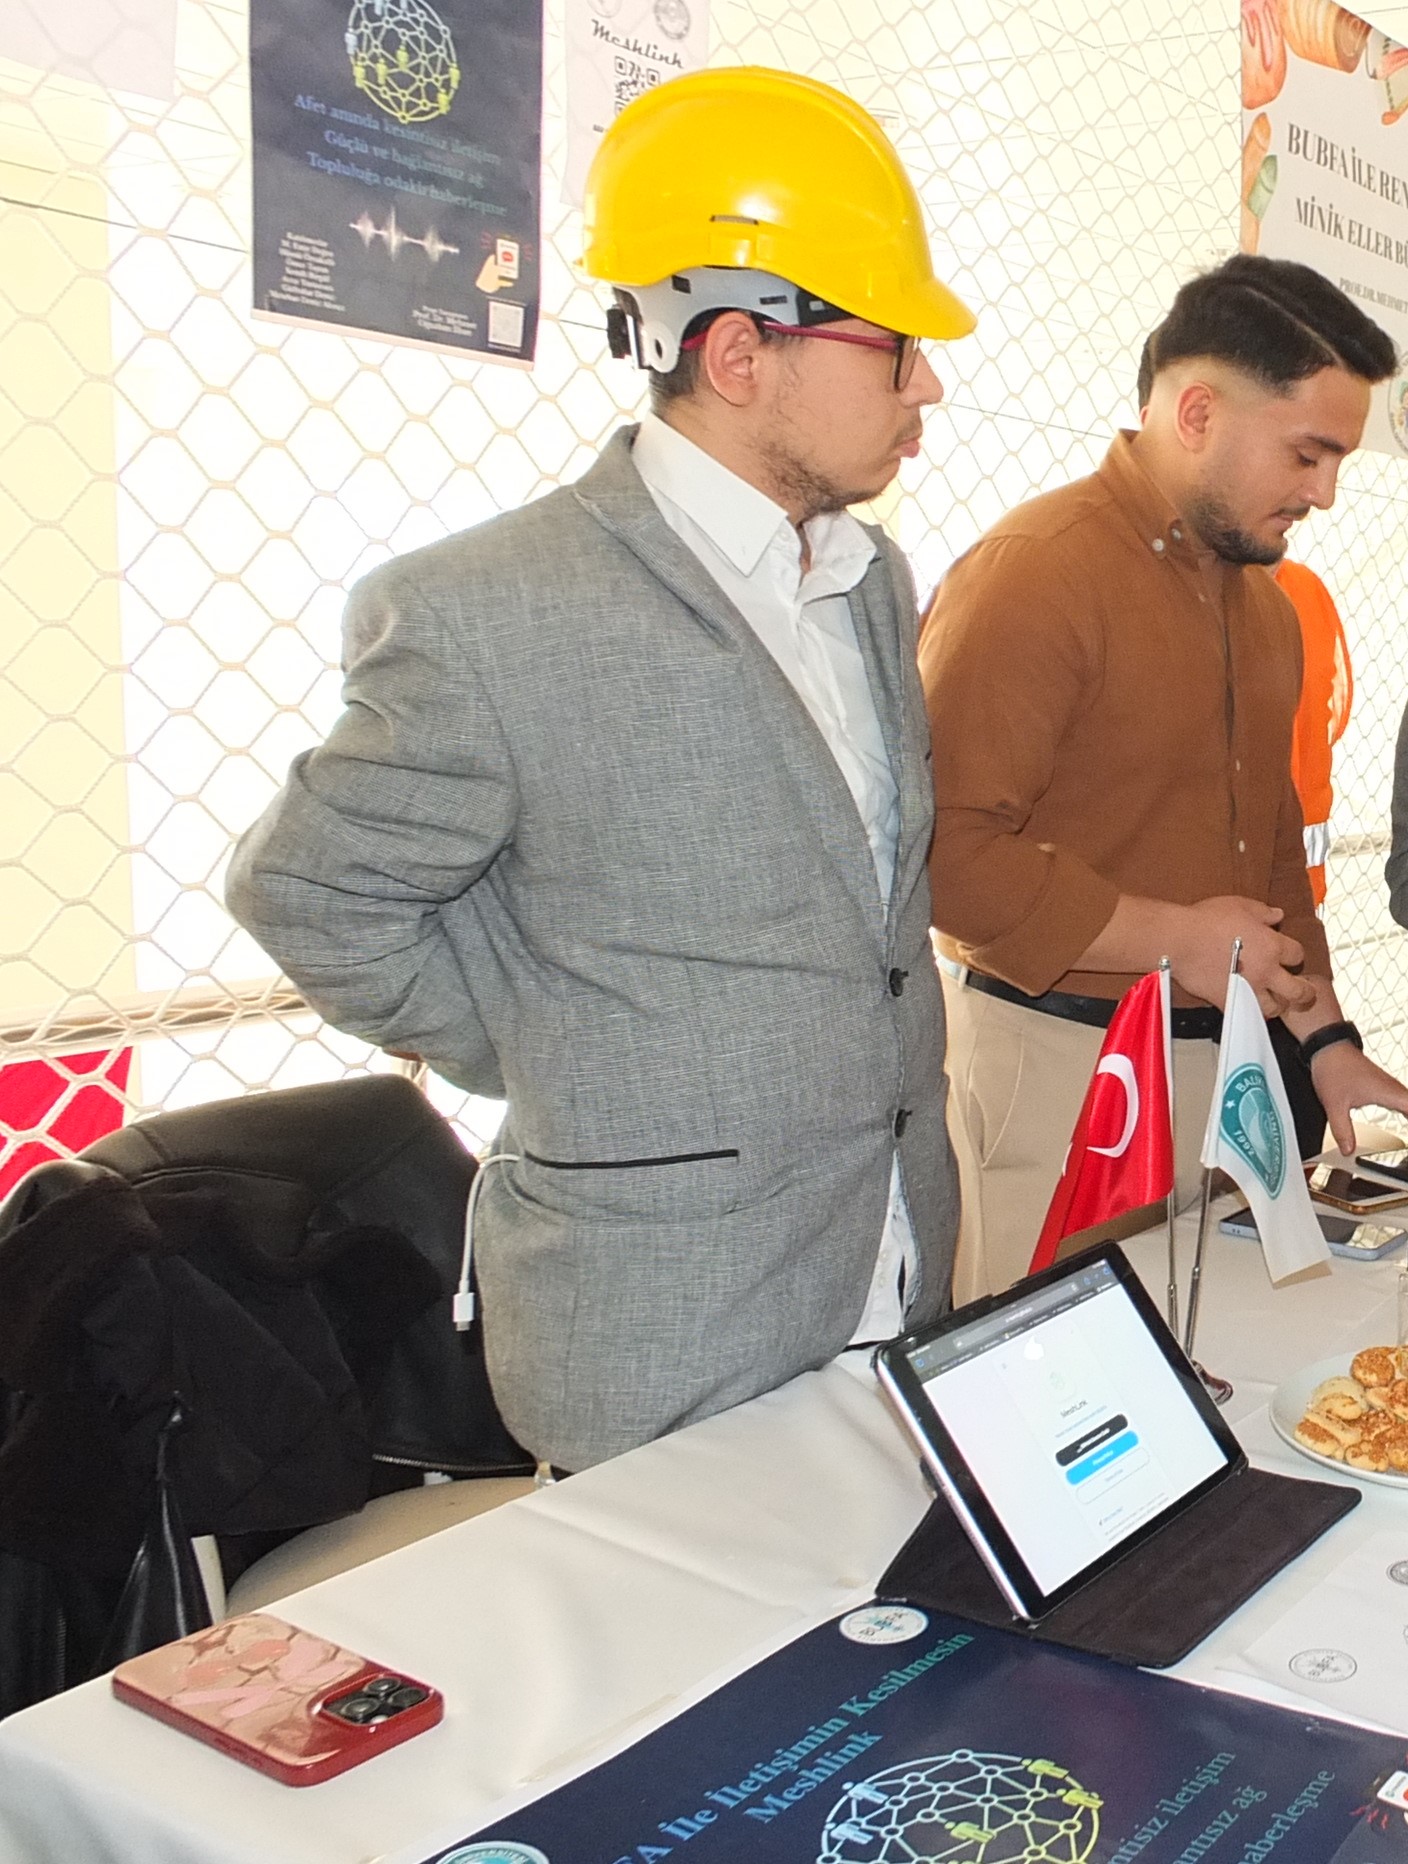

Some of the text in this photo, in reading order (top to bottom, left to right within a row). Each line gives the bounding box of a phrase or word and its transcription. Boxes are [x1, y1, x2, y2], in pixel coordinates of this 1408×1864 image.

[591, 18, 684, 69] Meshlink
[294, 95, 326, 115] Afet
[373, 146, 389, 159] ve
[1288, 122, 1349, 180] BUBFA
[1351, 146, 1376, 193] İLE
[1295, 195, 1344, 241] MİNİK
[1348, 218, 1393, 261] ELLER
[703, 1717, 850, 1809] İletişimin
[838, 1634, 975, 1717] Kesilmesin
[743, 1731, 884, 1824] Meshlink
[1155, 1751, 1236, 1816] iletişim
[1233, 1785, 1268, 1810] ağ
[1238, 1769, 1336, 1864] aberleşme
